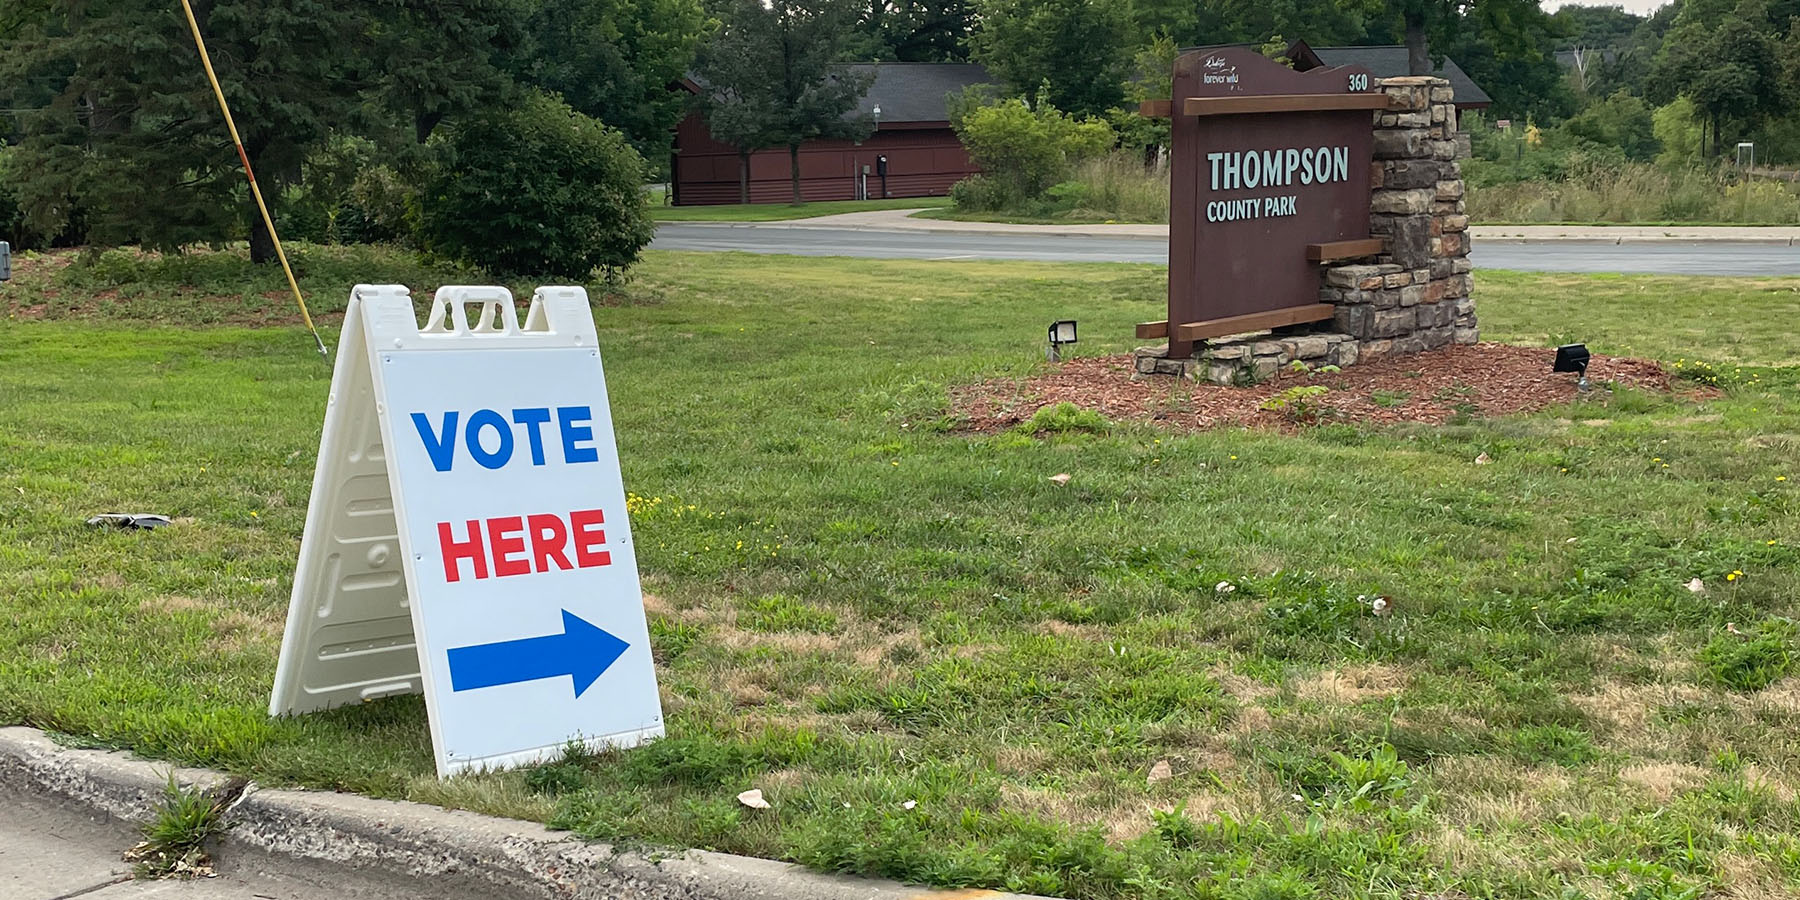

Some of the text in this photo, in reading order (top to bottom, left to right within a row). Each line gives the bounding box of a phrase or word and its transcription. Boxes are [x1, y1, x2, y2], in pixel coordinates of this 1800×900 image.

[1348, 73, 1368, 91] 360
[1207, 146, 1349, 190] THOMPSON
[1207, 196, 1297, 222] COUNTY PARK
[410, 406, 599, 472] VOTE
[437, 509, 612, 583] HERE
